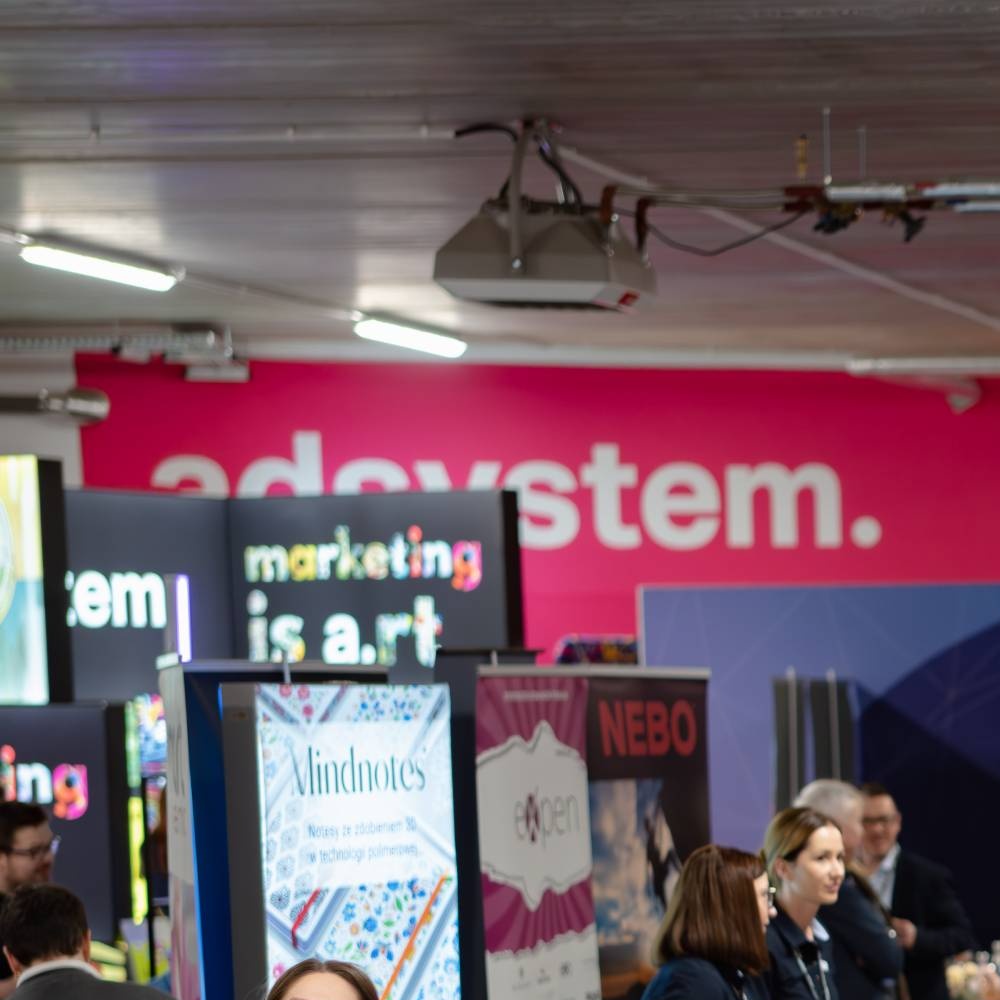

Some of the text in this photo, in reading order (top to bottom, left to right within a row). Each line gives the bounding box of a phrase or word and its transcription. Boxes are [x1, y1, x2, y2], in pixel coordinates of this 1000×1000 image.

[244, 525, 483, 592] marketing
[247, 589, 306, 664] is
[600, 700, 697, 757] NEBO
[289, 746, 426, 796] Mindnotes
